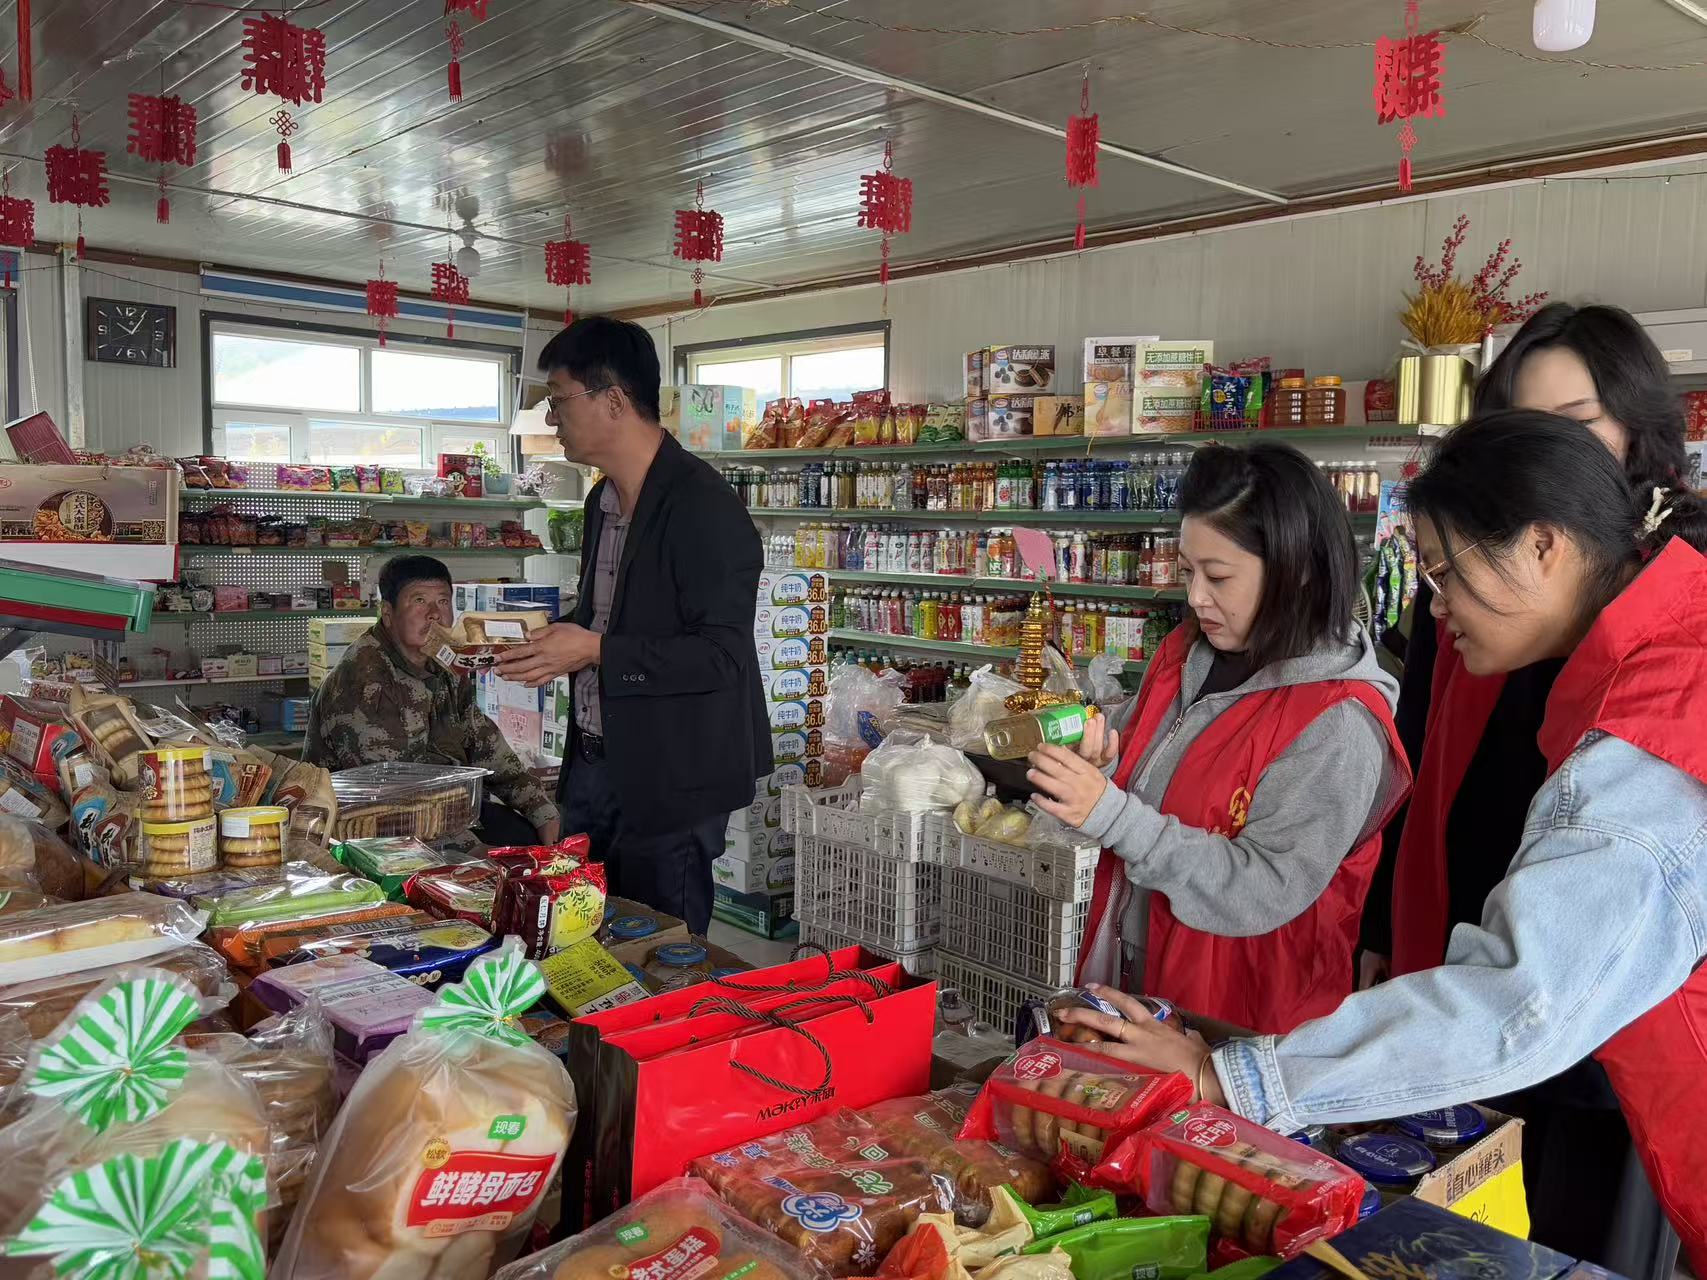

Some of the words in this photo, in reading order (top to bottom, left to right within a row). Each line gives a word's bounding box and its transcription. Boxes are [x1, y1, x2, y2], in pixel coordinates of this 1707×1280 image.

[126, 307, 137, 317] 12
[98, 324, 108, 335] 9
[155, 330, 164, 341] 3
[126, 348, 137, 359] 6
[781, 583, 801, 593] 纯牛奶
[807, 588, 825, 600] 36.0
[782, 615, 802, 624] 纯牛奶
[808, 620, 825, 632] 36.0
[781, 646, 801, 656] 纯牛奶
[807, 651, 825, 663] 36.0
[781, 678, 801, 688] 纯牛奶
[807, 682, 825, 695] 36.0
[778, 710, 798, 719] 纯牛奶
[805, 713, 822, 726] 36.0
[1191, 1120, 1235, 1146] 五仁月饼
[420, 1171, 543, 1207] 鲜酵母面包
